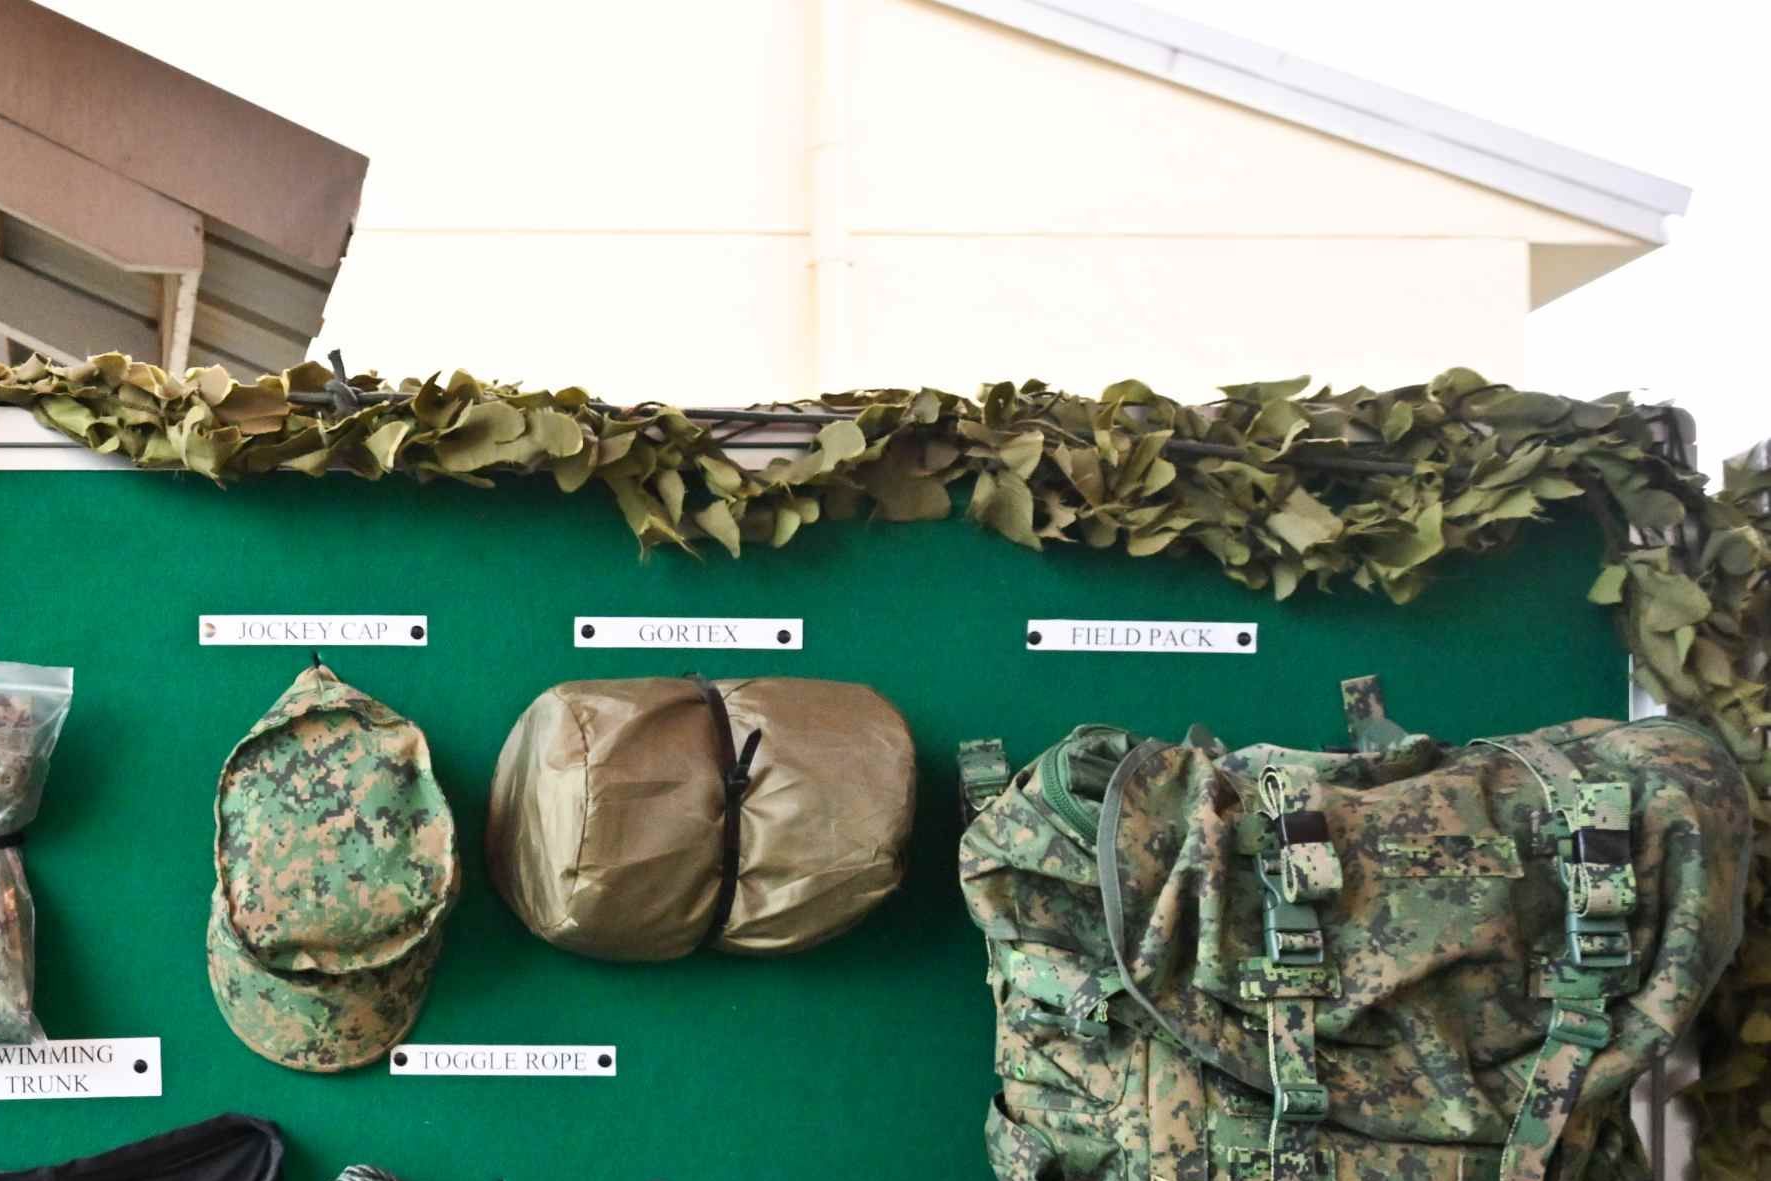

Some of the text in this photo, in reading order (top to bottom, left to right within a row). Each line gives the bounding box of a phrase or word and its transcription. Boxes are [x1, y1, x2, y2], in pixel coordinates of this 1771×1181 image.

[238, 622, 388, 641] JOCKEY CAP
[638, 624, 739, 643] GORTEX
[1072, 627, 1213, 648] FIELD PACK
[419, 1051, 588, 1071] TOGGLE ROPE
[5, 1073, 90, 1095] TRUNK
